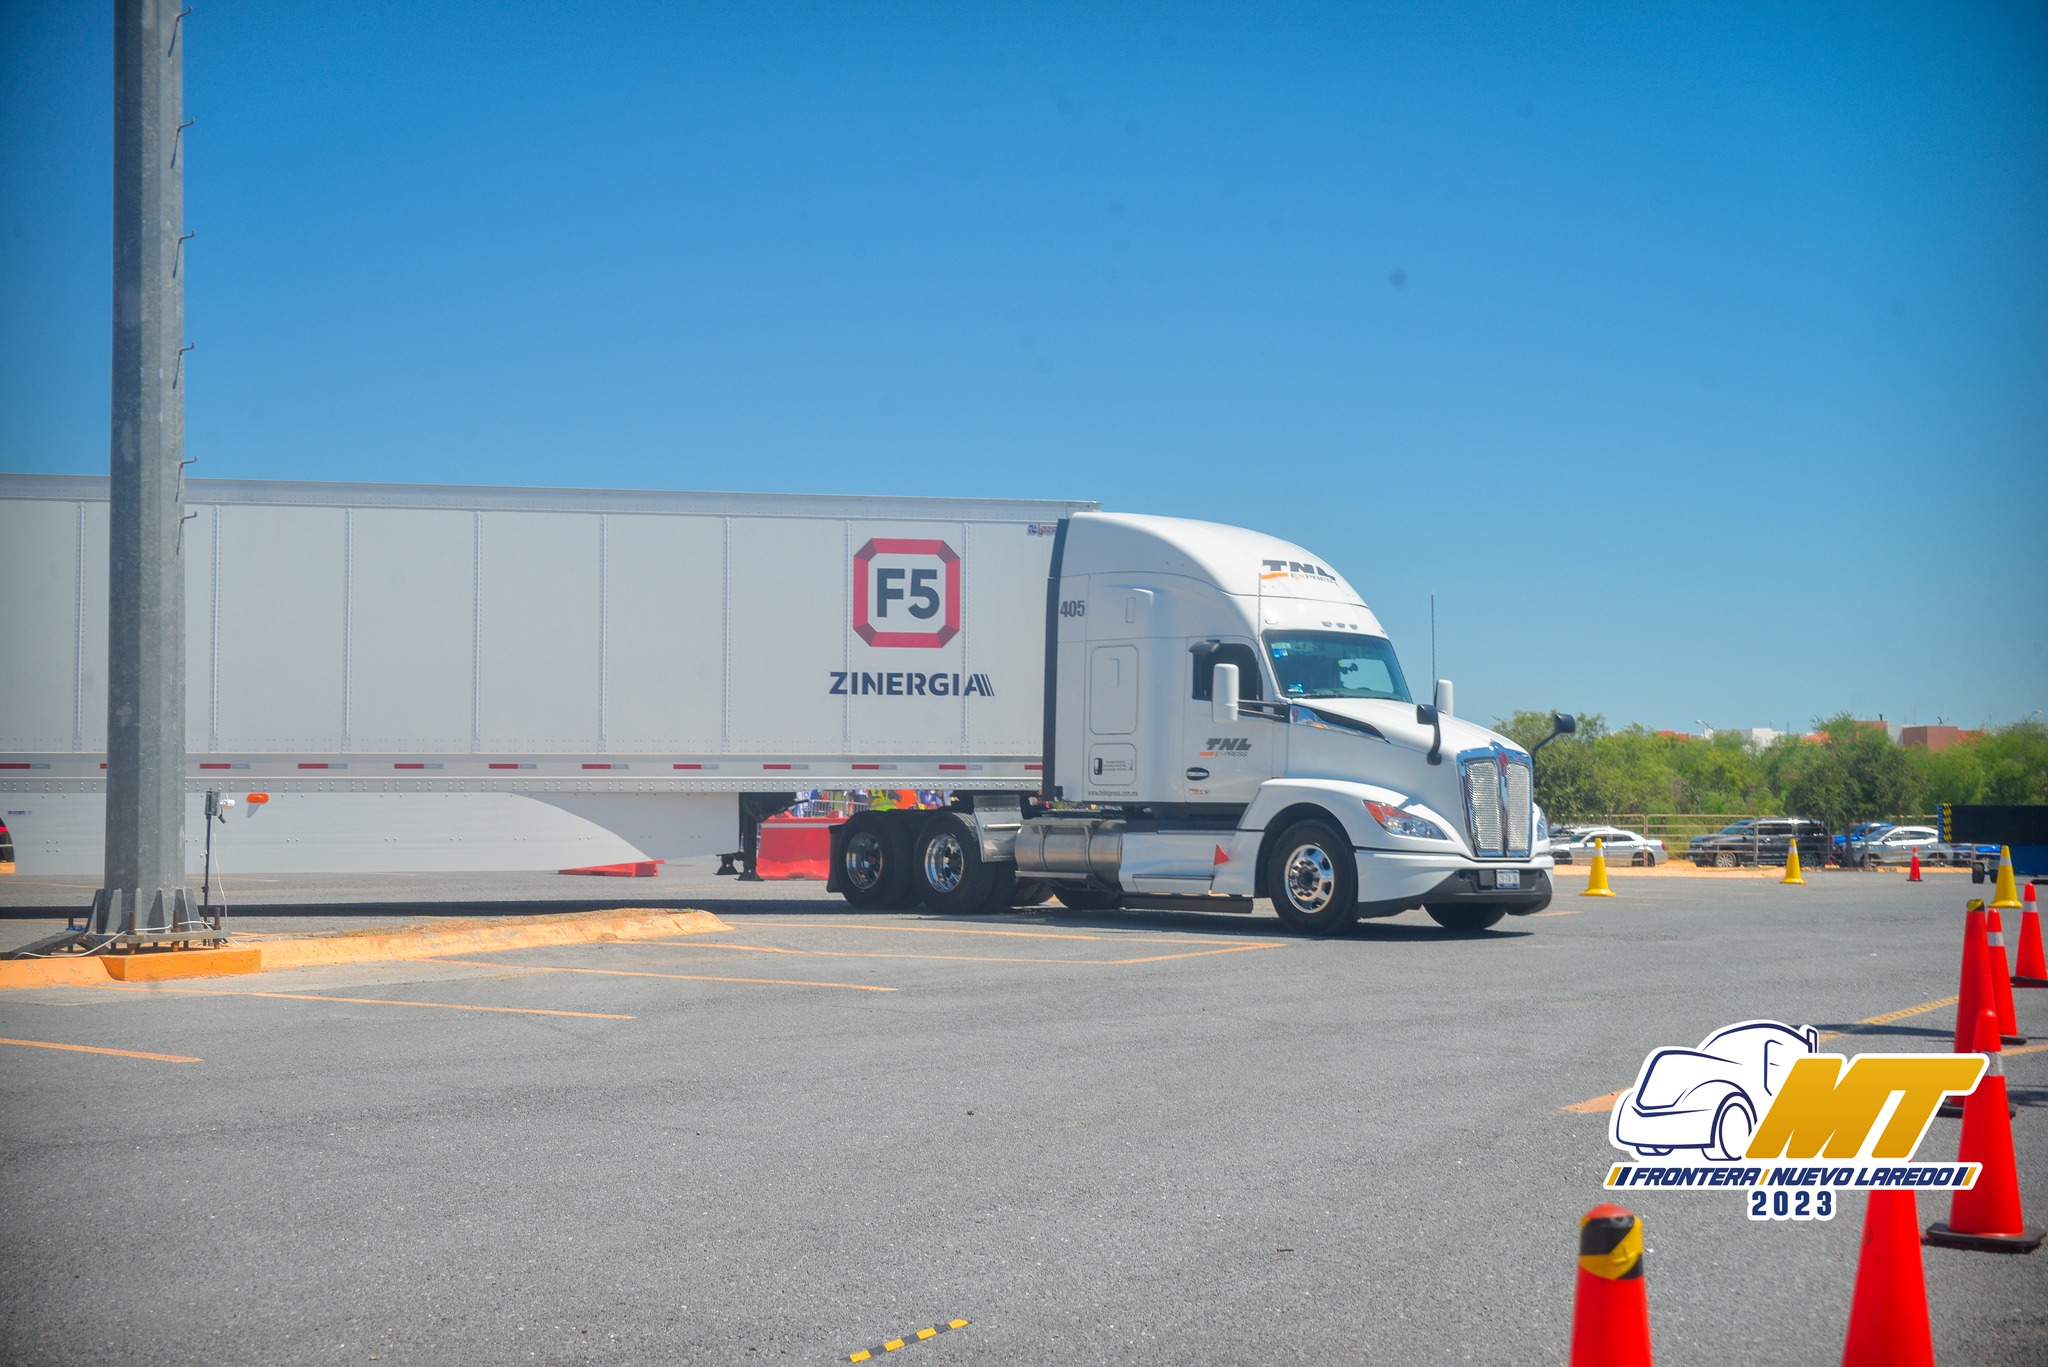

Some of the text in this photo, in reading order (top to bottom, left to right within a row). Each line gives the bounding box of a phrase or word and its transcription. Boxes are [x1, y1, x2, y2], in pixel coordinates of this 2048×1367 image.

[1262, 559, 1336, 581] TNL
[876, 567, 940, 619] F5
[1060, 600, 1085, 617] 405
[829, 671, 995, 697] ZINERGIA
[1206, 738, 1252, 751] TNL
